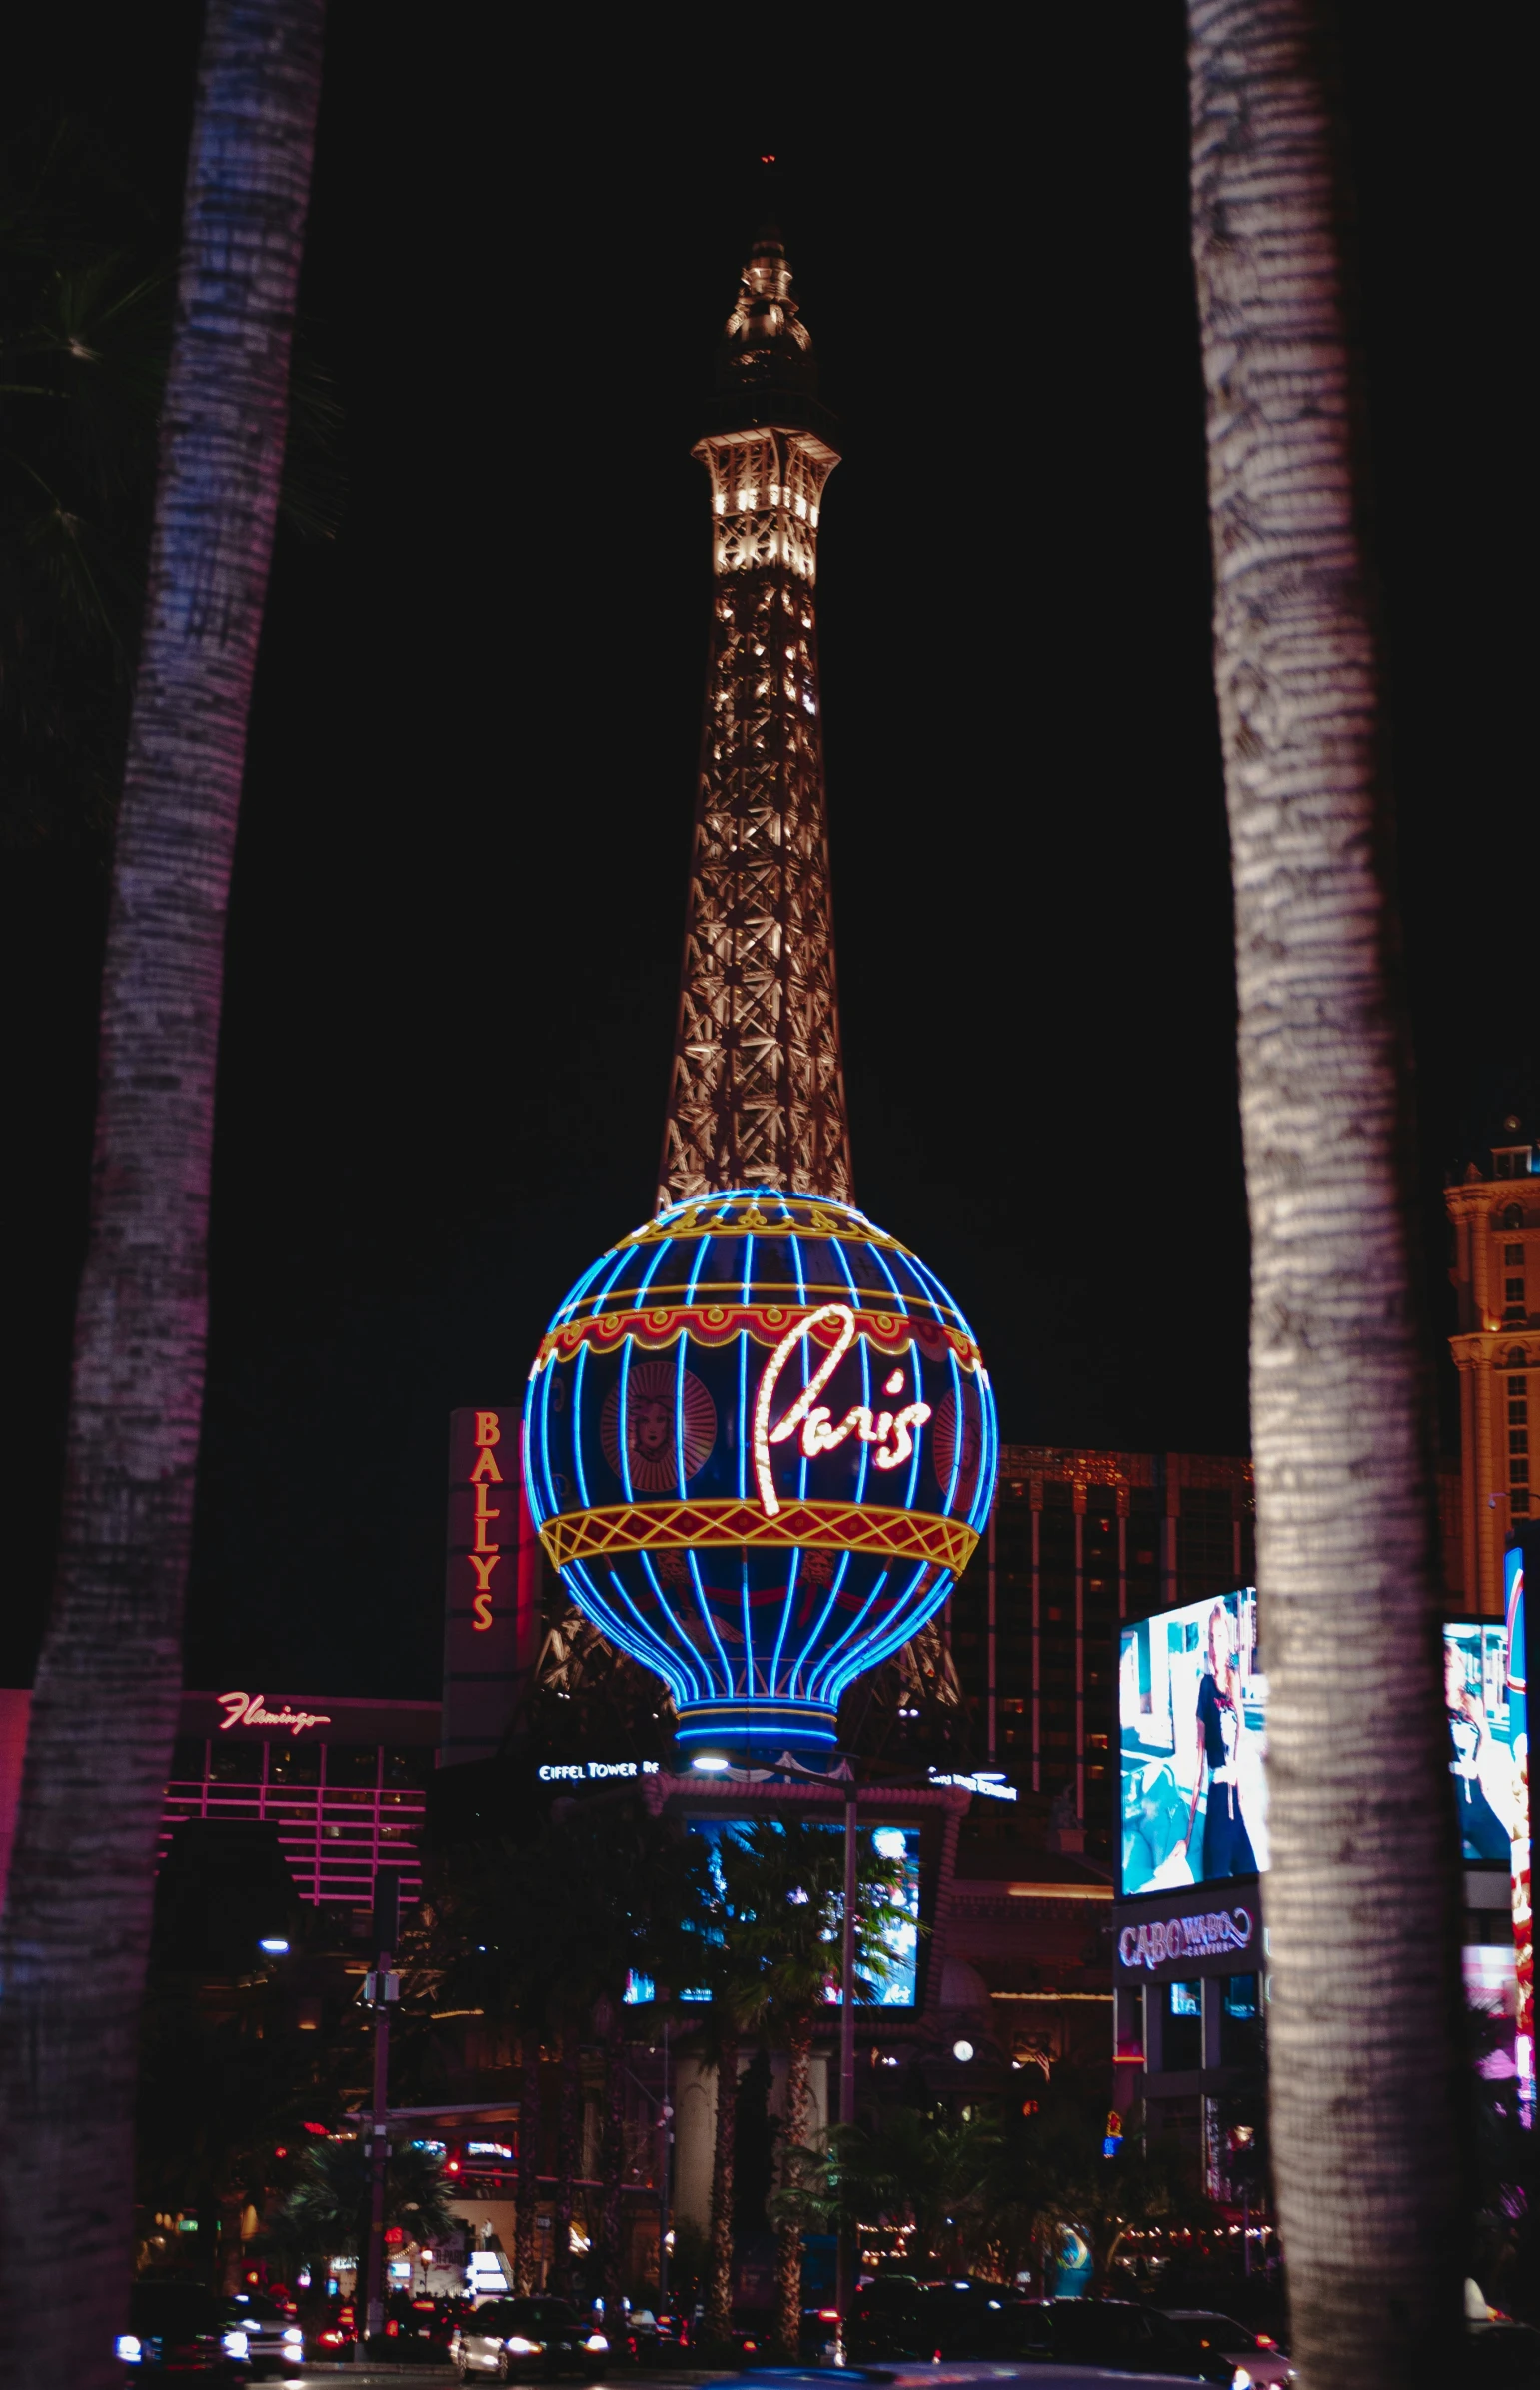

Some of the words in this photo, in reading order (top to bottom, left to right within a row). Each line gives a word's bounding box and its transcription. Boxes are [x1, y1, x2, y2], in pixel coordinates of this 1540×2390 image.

[753, 1302, 934, 1517] Paris
[468, 1411, 504, 1631] BALLYS
[217, 1690, 332, 1736] Flamingo
[537, 1764, 586, 1781] EIFFEL
[587, 1761, 637, 1779] TOWER
[1117, 1918, 1183, 1970] CABO
[1181, 1907, 1253, 1949] WABO
